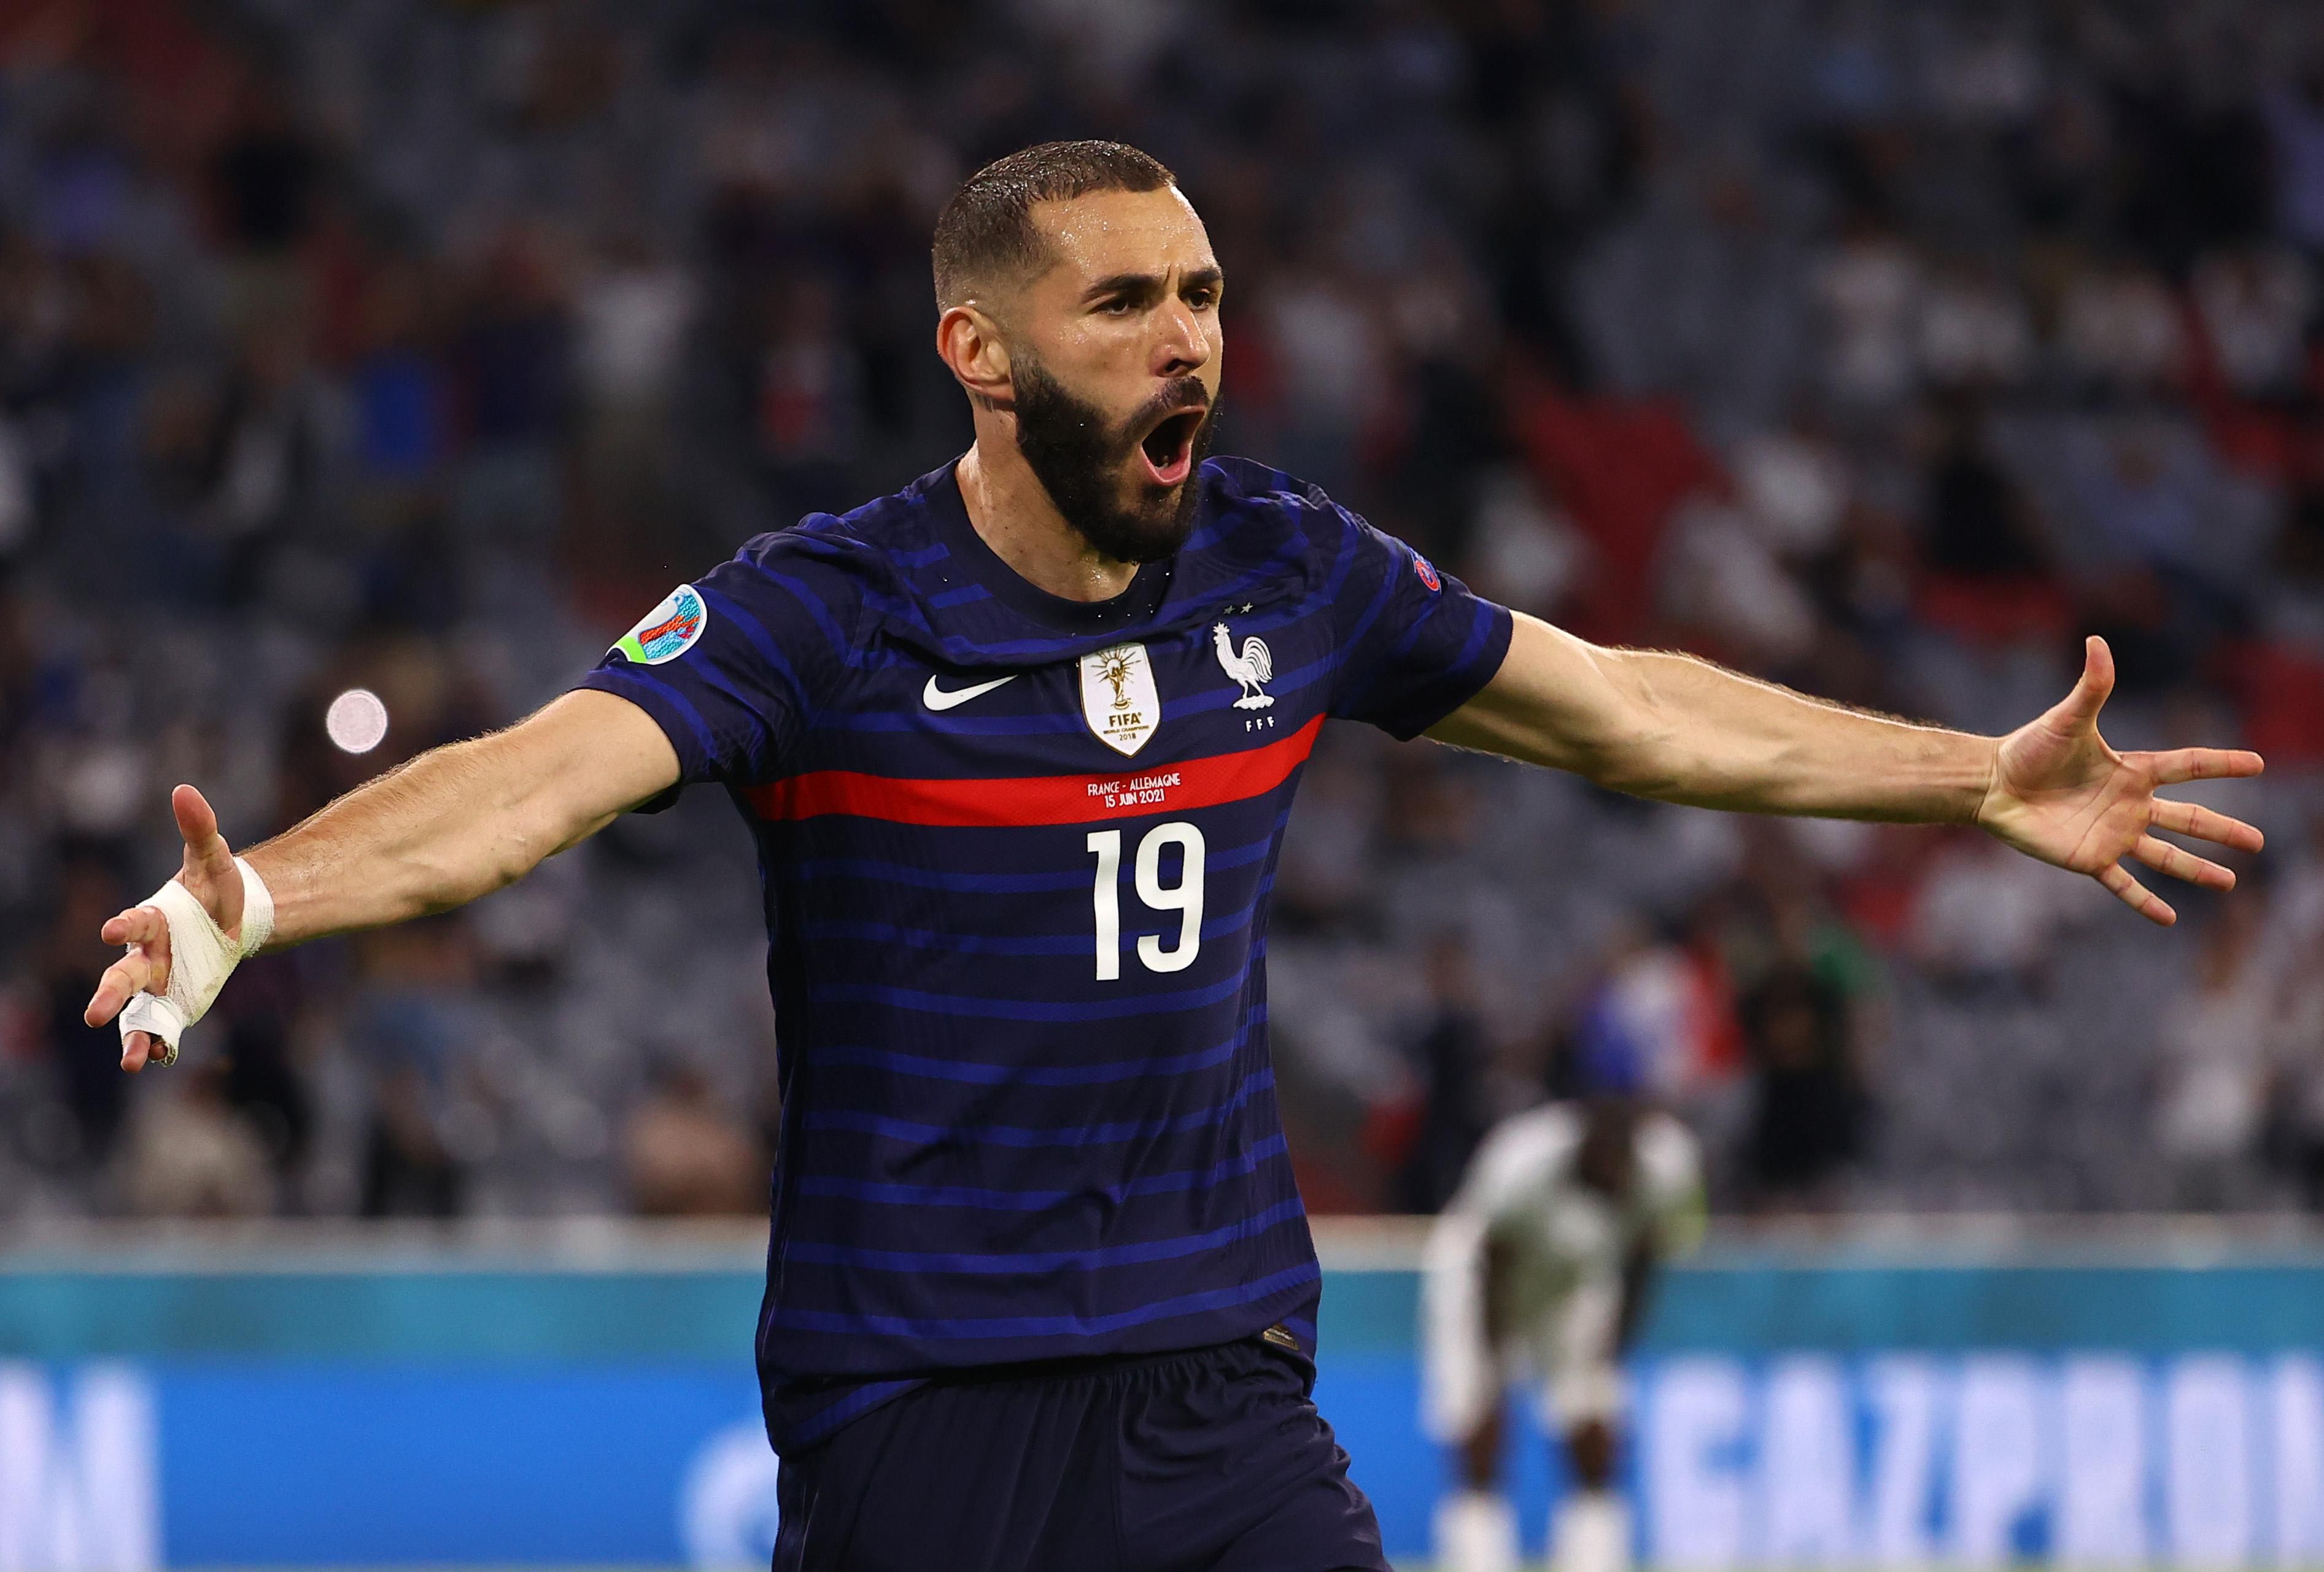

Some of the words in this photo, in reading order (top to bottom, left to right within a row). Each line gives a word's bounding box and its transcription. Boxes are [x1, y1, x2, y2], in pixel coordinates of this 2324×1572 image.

[1119, 732, 1136, 741] 2018
[1088, 781, 1120, 796] FRANCE
[1129, 773, 1180, 791] ALLEMAGNE
[1105, 795, 1116, 808] 15
[1119, 791, 1137, 806] JUIN
[1139, 788, 1164, 804] 2021
[1087, 821, 1205, 980] 19
